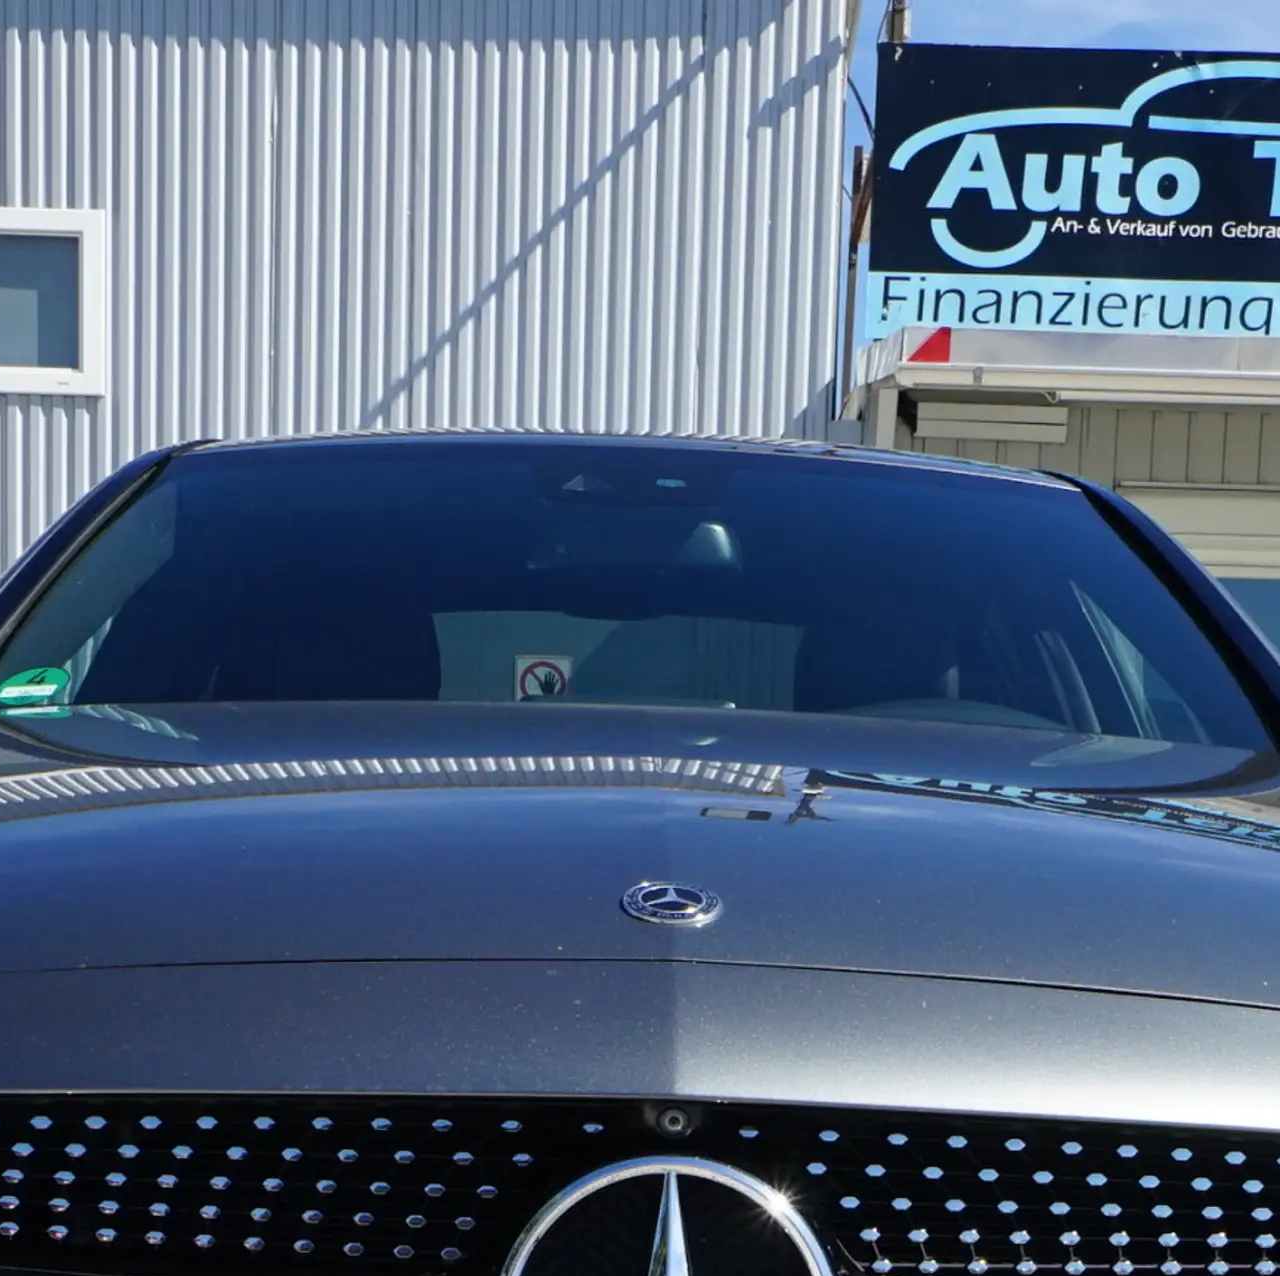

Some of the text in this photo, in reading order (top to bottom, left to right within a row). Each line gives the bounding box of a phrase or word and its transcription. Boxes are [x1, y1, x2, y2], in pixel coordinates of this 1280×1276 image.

[926, 133, 1201, 217] Auto
[1050, 217, 1084, 233] An-
[1087, 217, 1101, 234] &
[1106, 218, 1177, 238] Verkauf
[1179, 224, 1213, 239] von
[882, 274, 1274, 337] Finanzierung
